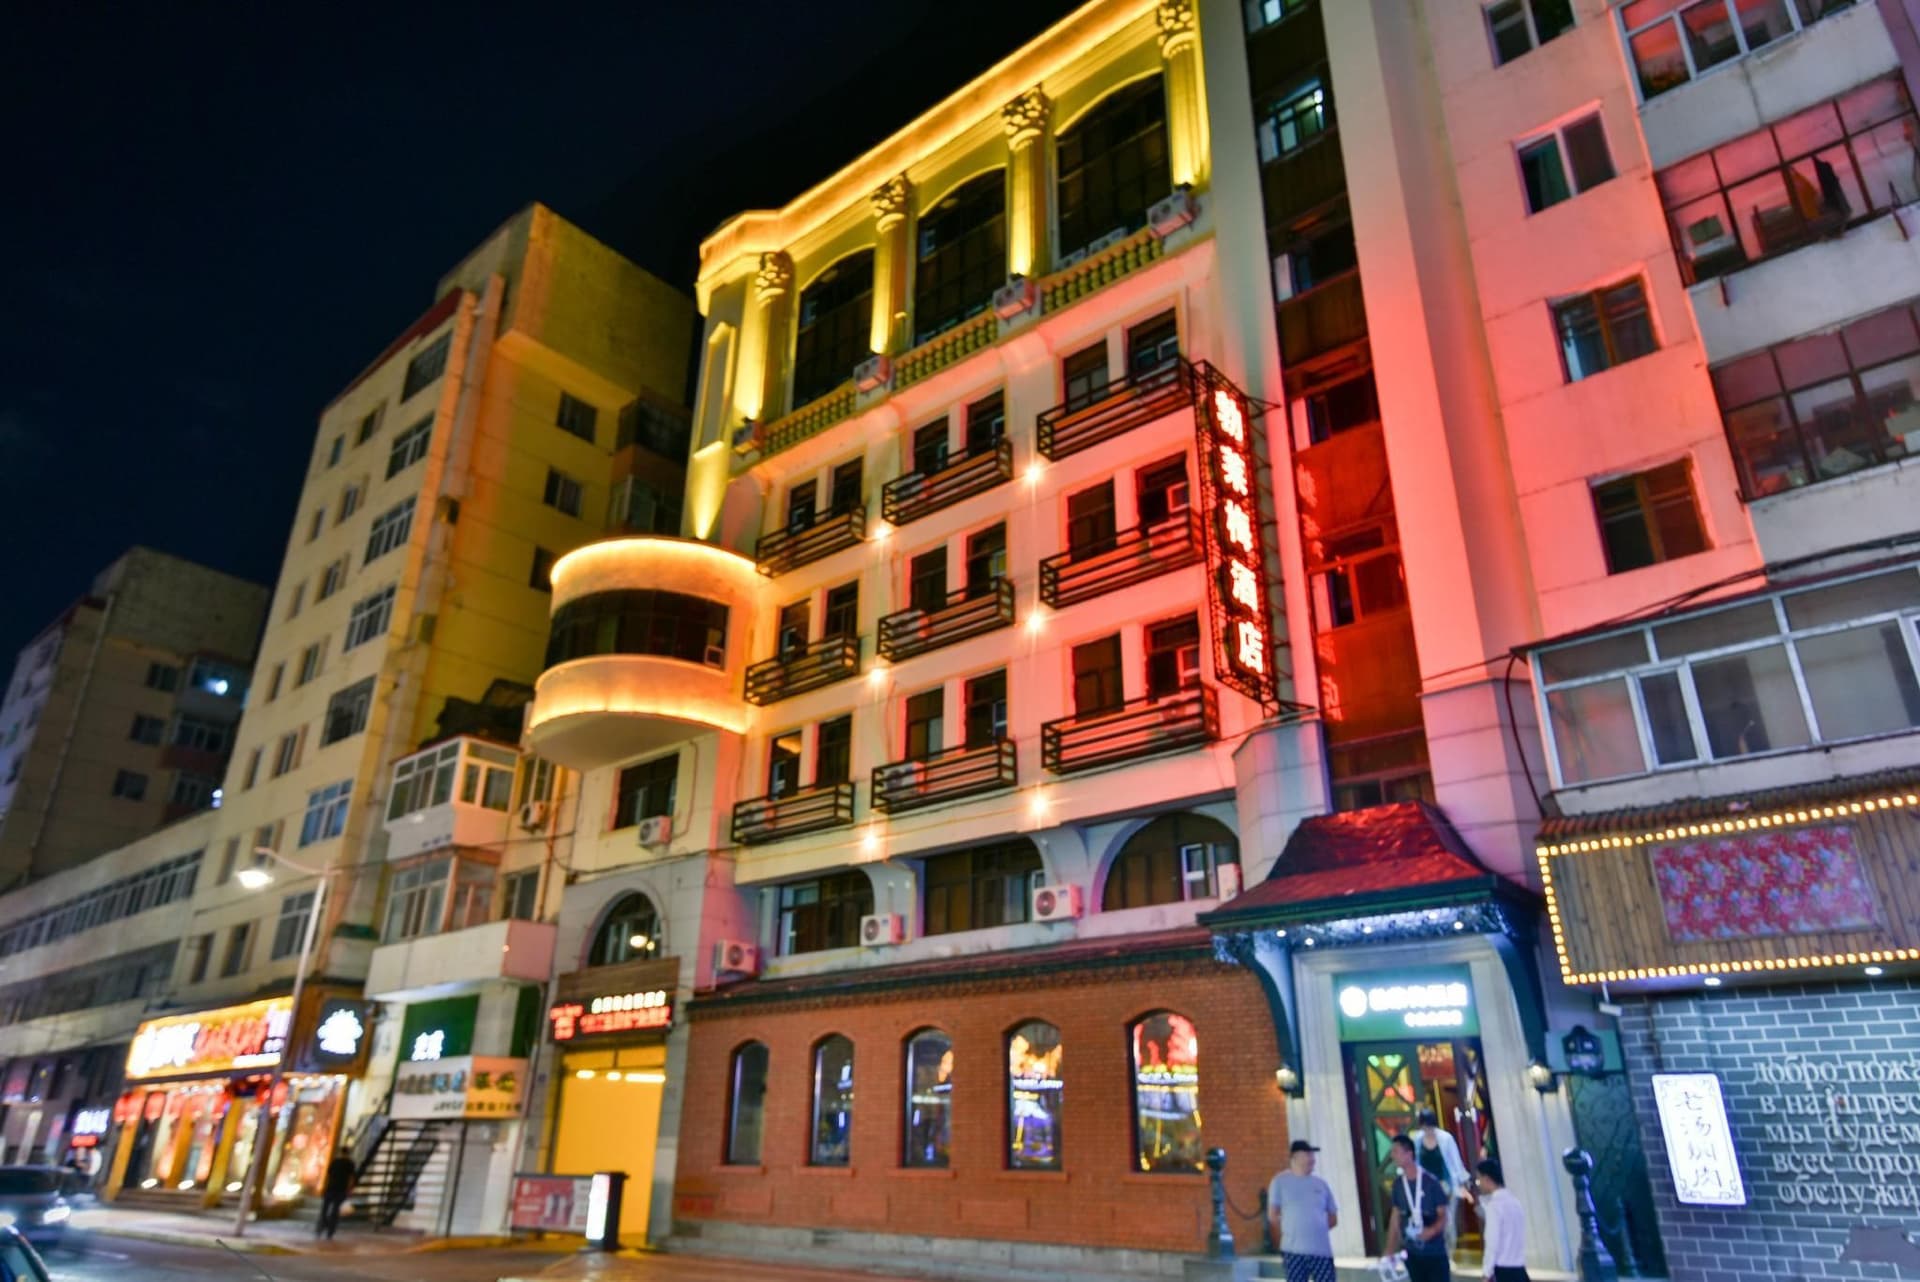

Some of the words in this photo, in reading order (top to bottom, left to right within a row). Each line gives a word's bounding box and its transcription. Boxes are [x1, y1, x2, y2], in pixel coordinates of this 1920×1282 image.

[1753, 1055, 1837, 1090] добро
[1760, 1095, 1776, 1114] в
[1764, 1124, 1813, 1144] мы
